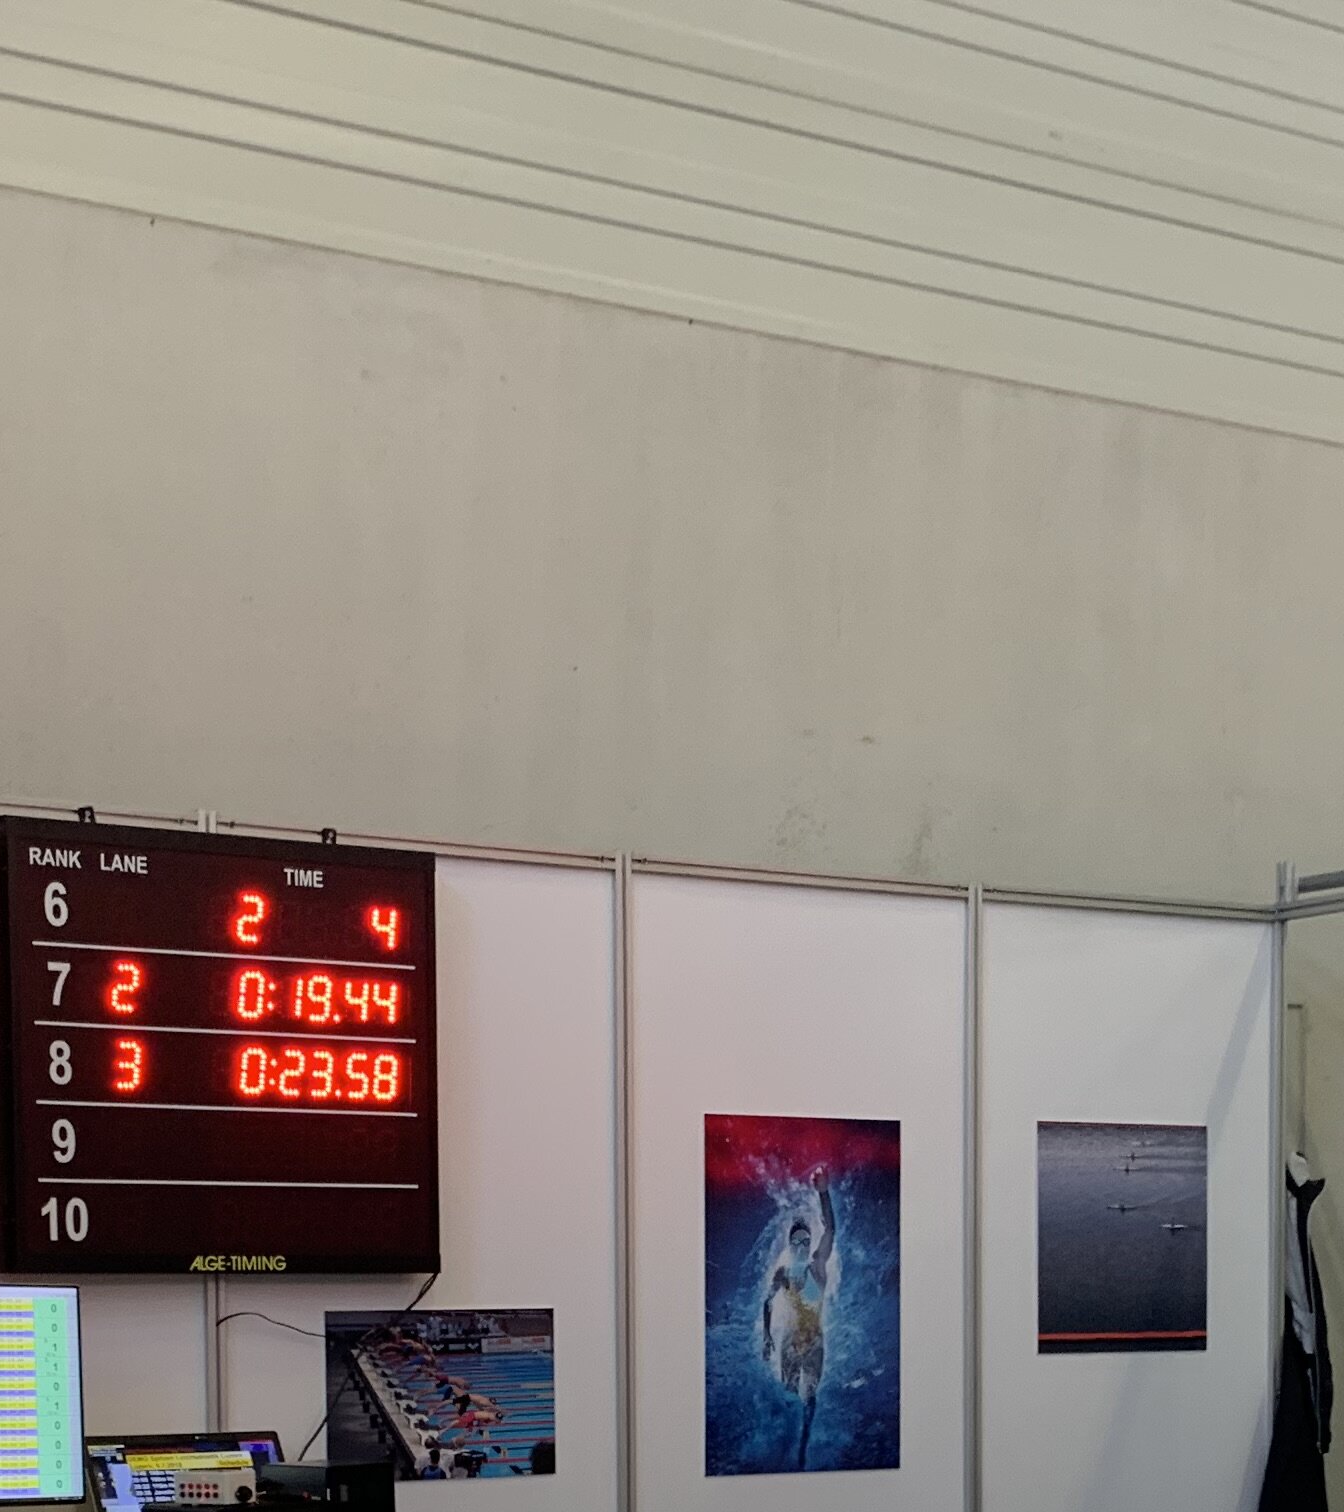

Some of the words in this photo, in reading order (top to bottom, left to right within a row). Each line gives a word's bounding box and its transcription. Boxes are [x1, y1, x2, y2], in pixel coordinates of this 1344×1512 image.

[29, 847, 82, 870] RANK
[100, 853, 148, 875] LANE
[284, 868, 323, 889] TIME
[44, 883, 68, 926] 6
[235, 895, 264, 943] 2
[370, 908, 398, 949] 4
[47, 962, 71, 1006] 7
[112, 964, 140, 1012] 2
[236, 971, 398, 1023] 0:19.44
[49, 1041, 72, 1085] 8
[116, 1041, 142, 1090] 3
[239, 1048, 399, 1101] 0:23.58
[52, 1120, 76, 1163] 9
[40, 1198, 89, 1242] 10
[189, 1255, 286, 1271] ALGE-TIMING
